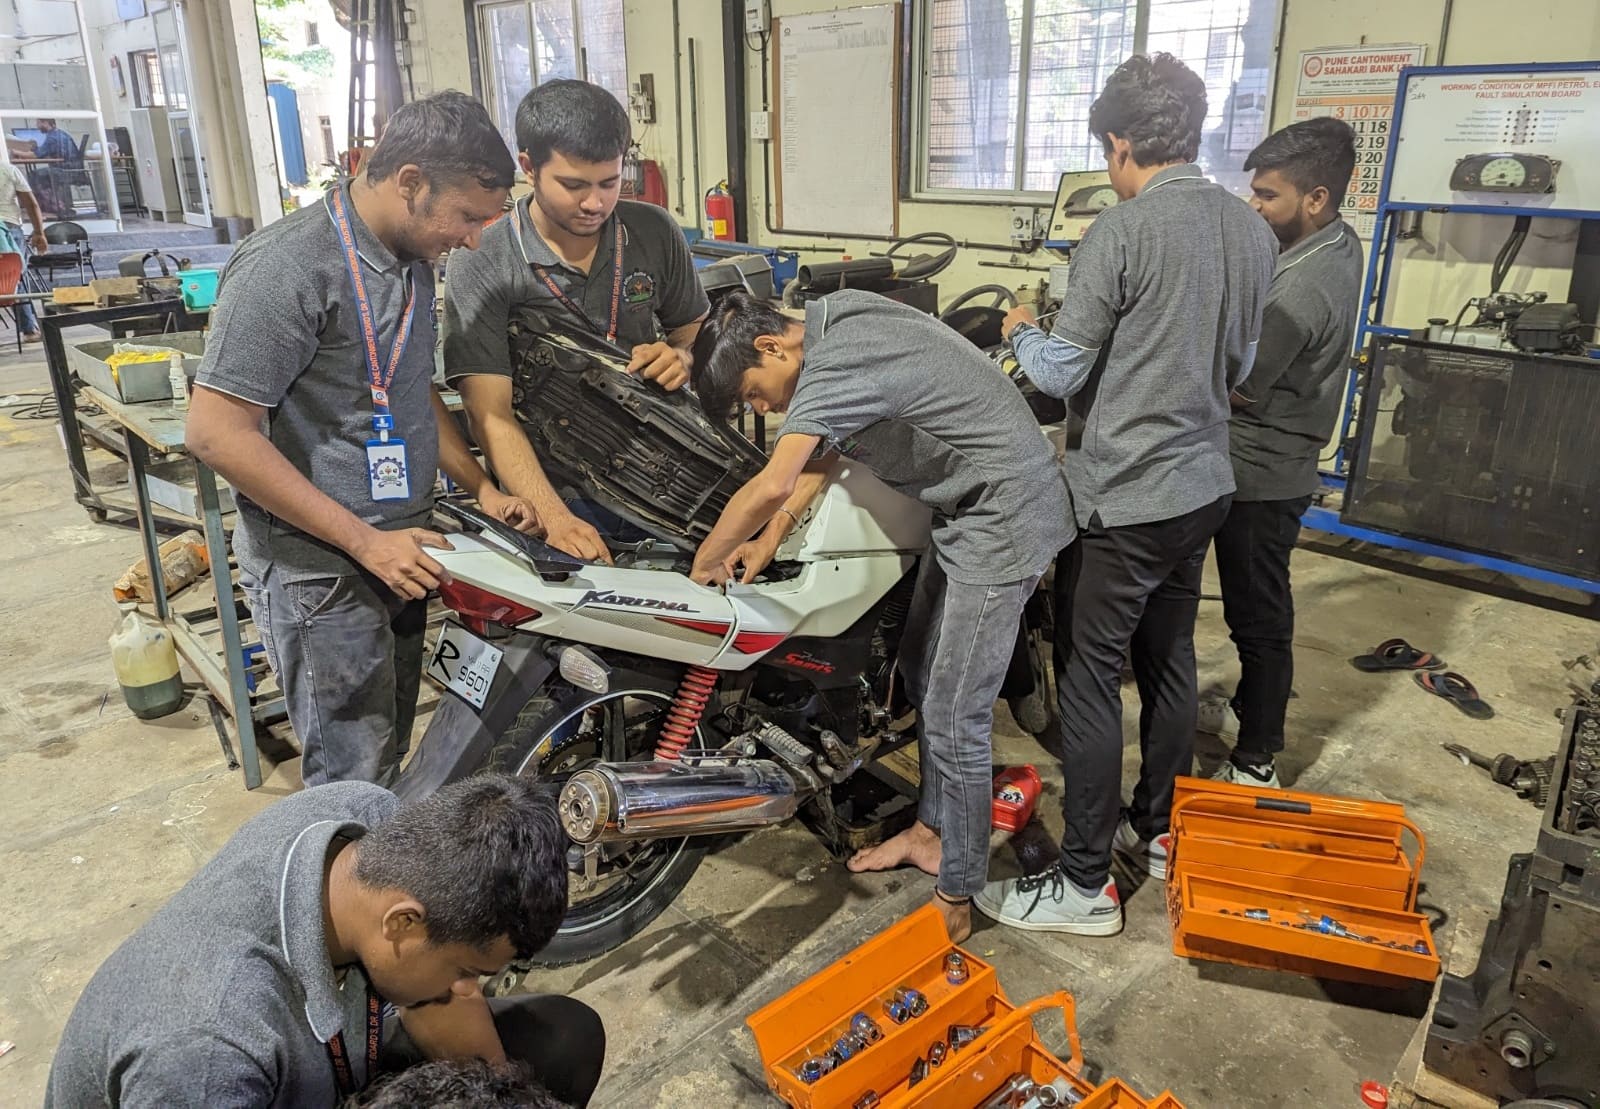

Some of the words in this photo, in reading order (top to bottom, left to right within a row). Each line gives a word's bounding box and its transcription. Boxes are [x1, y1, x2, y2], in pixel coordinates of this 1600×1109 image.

[1325, 58, 1349, 66] PUNE
[1351, 54, 1412, 64] CANTONMENT
[1324, 66, 1366, 75] SAHAKARI
[1370, 65, 1394, 73] BANK
[1441, 83, 1476, 91] WORKING
[1478, 82, 1521, 90] CONDITION
[1523, 82, 1534, 90] OF
[1558, 80, 1591, 88] PETROL
[1501, 91, 1550, 99] SIMULATION
[1551, 90, 1582, 98] BOARD
[1336, 107, 1344, 119] 3
[1353, 106, 1368, 118] 10
[1373, 106, 1390, 118] 17
[1371, 122, 1387, 133] 18
[1368, 137, 1385, 148] 19
[1365, 152, 1382, 163] 20
[1363, 167, 1379, 178] 21
[1361, 182, 1378, 193] 22
[1359, 197, 1376, 208] 23
[567, 590, 699, 612] KARIZMA
[432, 639, 460, 681] R
[458, 665, 489, 696] 9601
